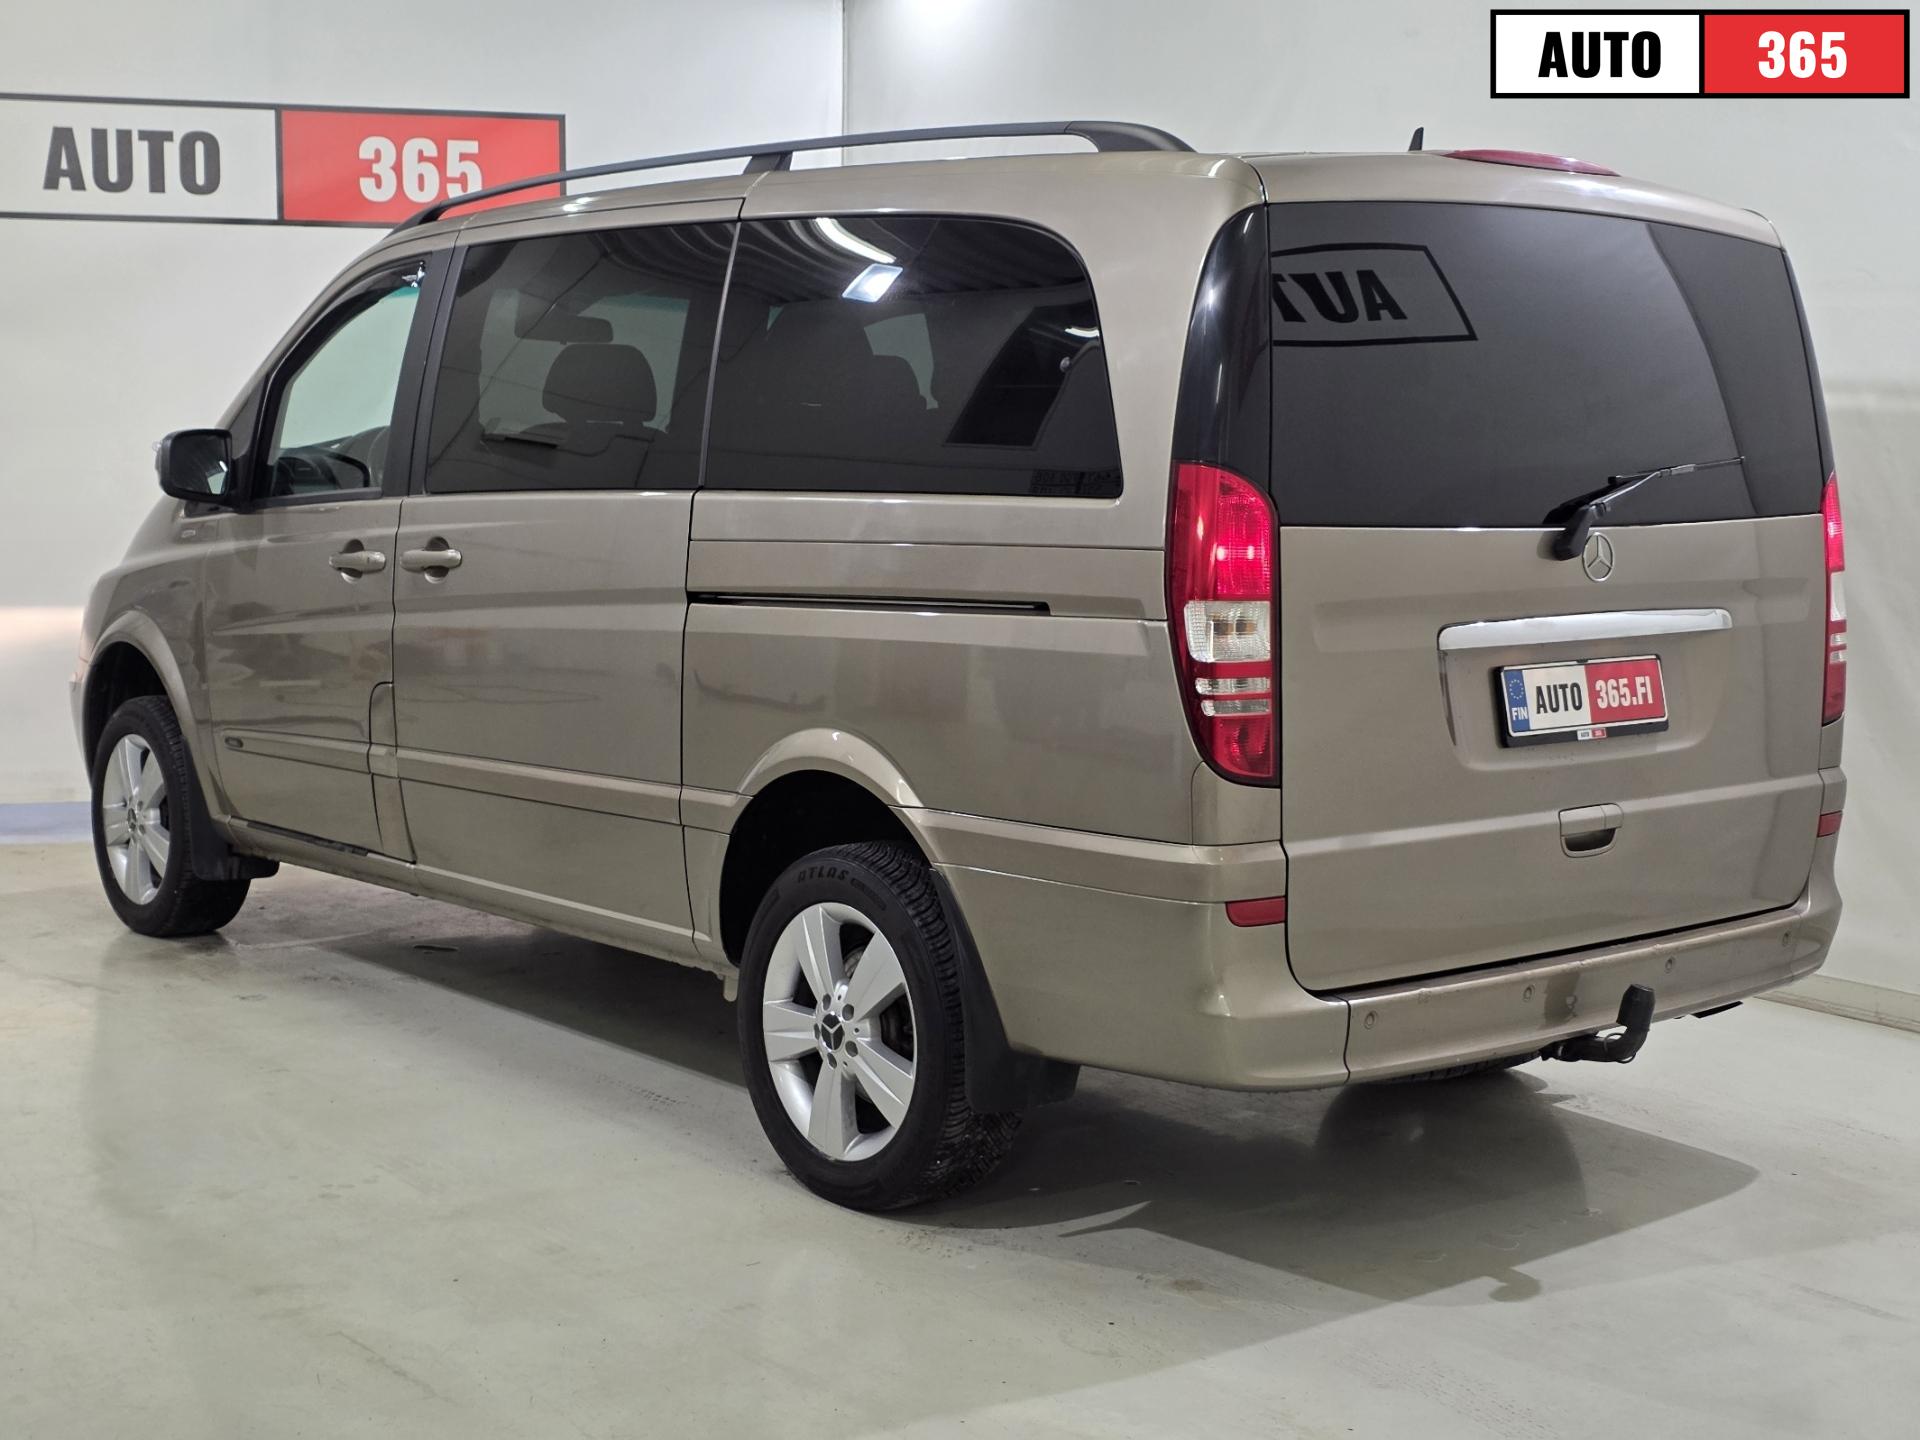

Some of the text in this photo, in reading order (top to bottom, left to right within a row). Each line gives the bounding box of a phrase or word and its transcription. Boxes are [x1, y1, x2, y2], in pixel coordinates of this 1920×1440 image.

[43, 126, 483, 203] AUTO 365
[1535, 675, 1653, 714] AUTO 365.FI
[1511, 706, 1529, 721] FIN
[798, 865, 850, 883] ATLAS
